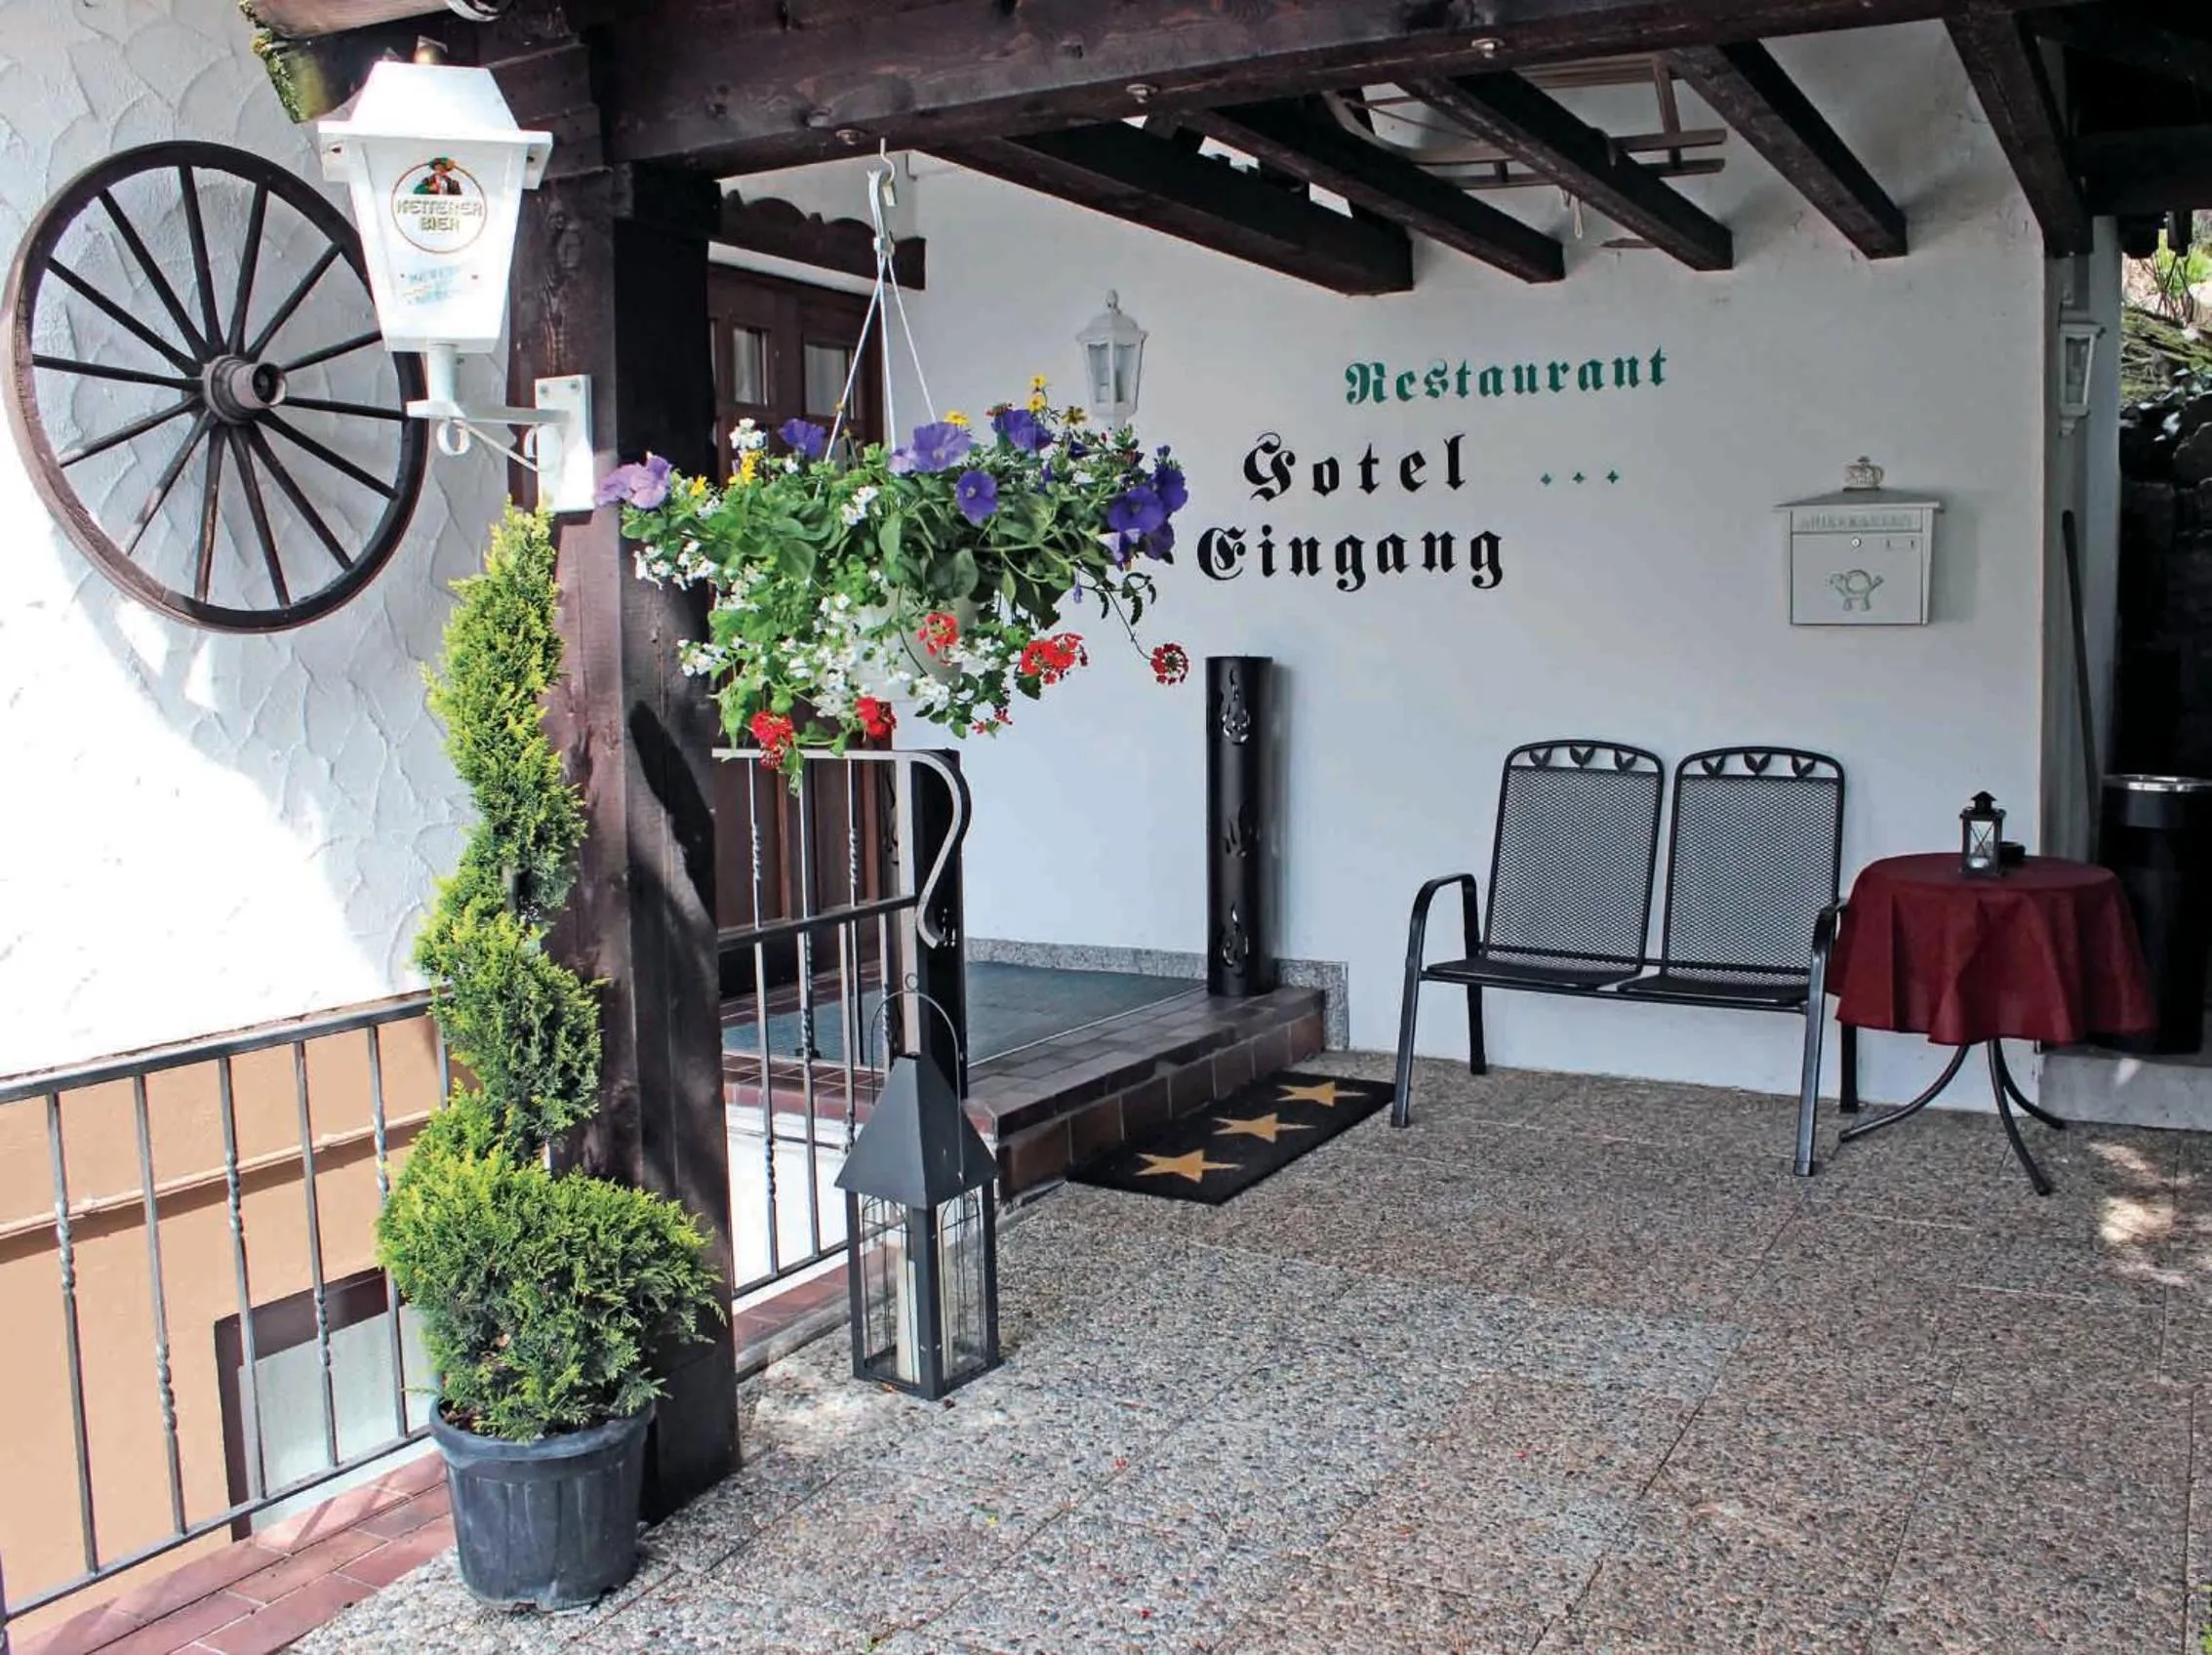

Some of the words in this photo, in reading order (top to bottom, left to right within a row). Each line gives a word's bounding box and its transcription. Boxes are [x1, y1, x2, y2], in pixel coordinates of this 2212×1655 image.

[422, 217, 460, 231] BIER
[1346, 347, 1667, 404] Restaurant
[1244, 432, 1465, 501] Hotel
[1197, 525, 1503, 591] Eingang
